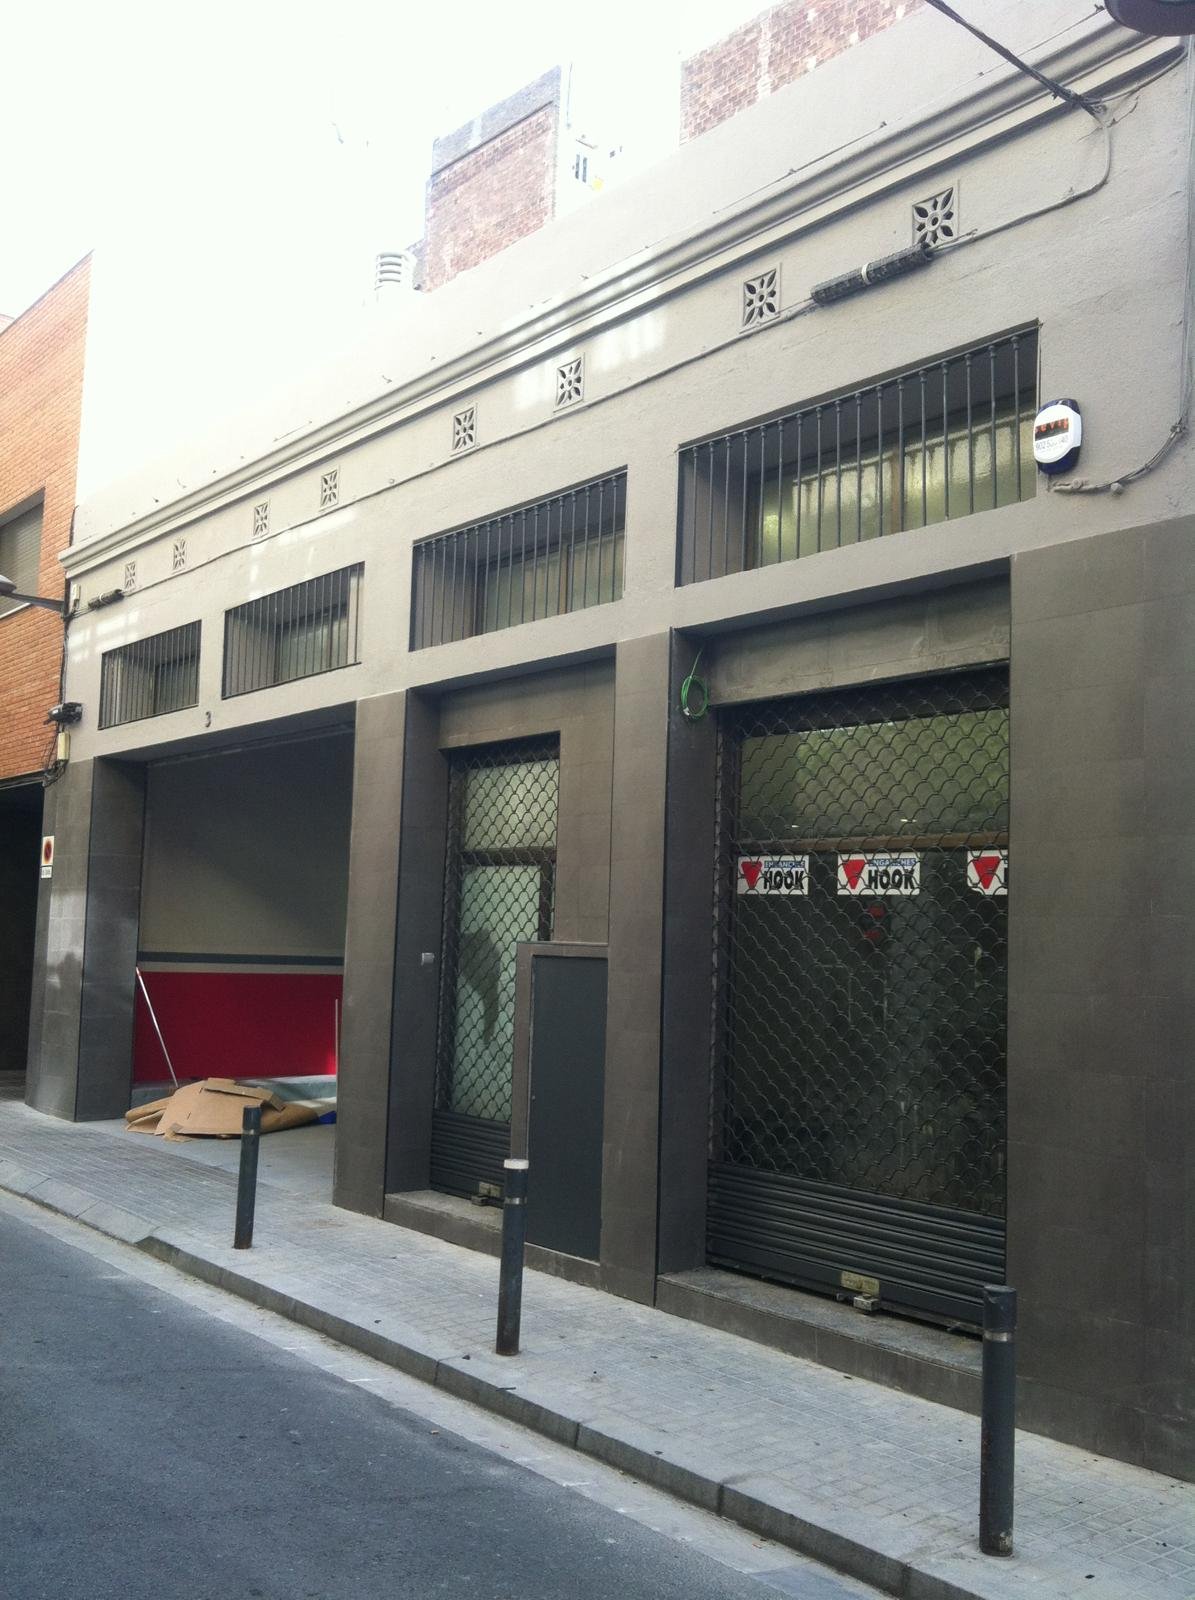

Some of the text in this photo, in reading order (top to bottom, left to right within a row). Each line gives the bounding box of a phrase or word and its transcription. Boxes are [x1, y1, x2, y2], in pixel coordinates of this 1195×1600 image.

[205, 711, 212, 728] 3
[763, 870, 805, 890] HOOK
[868, 869, 915, 889] HOOK
